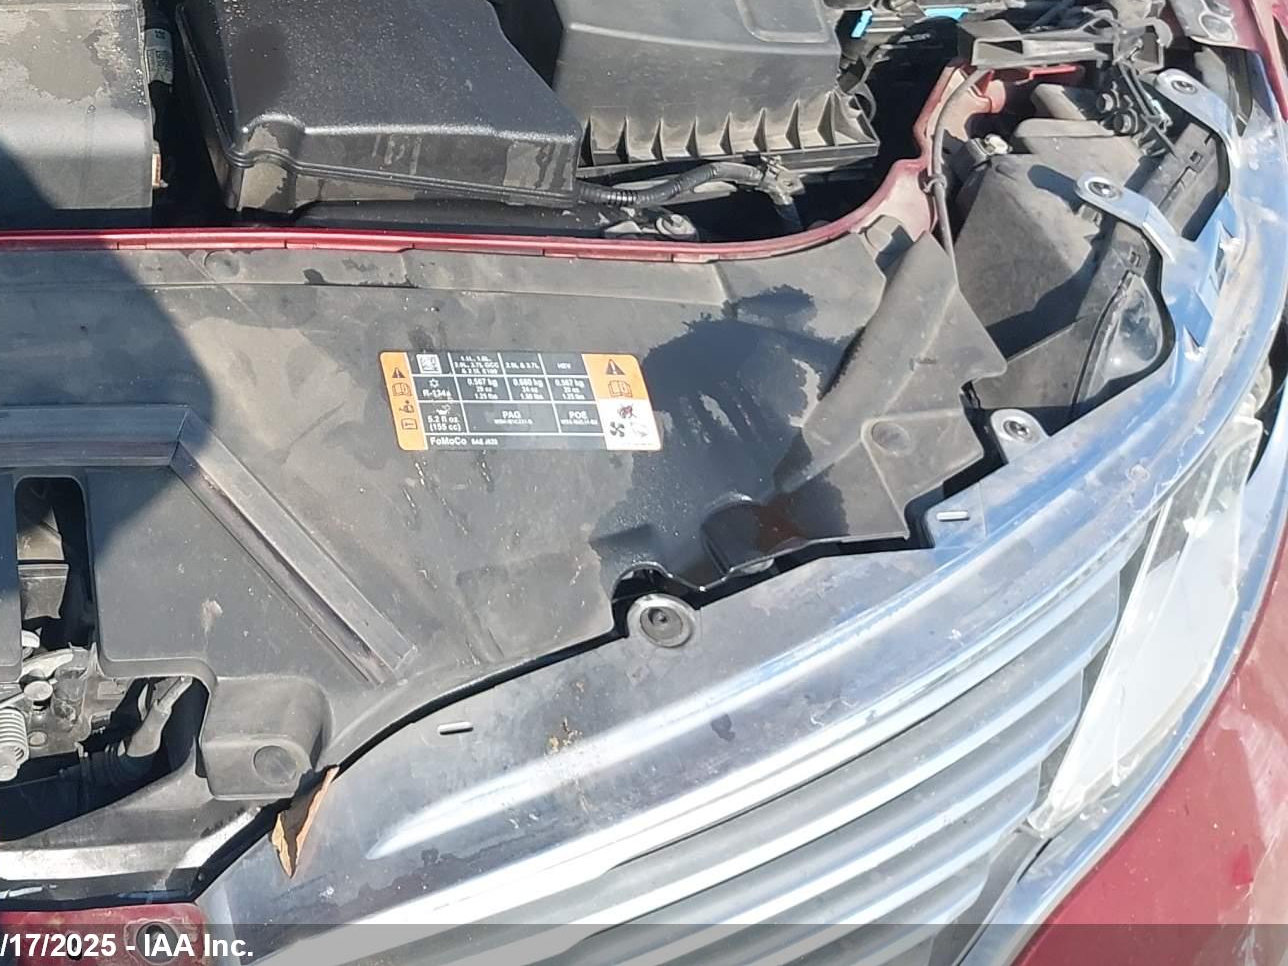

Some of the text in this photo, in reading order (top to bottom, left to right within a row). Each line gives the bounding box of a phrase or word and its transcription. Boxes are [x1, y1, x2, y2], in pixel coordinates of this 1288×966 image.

[428, 415, 440, 423] 5.2
[429, 423, 462, 432] (155 cc)
[430, 436, 467, 445] FoMoCo
